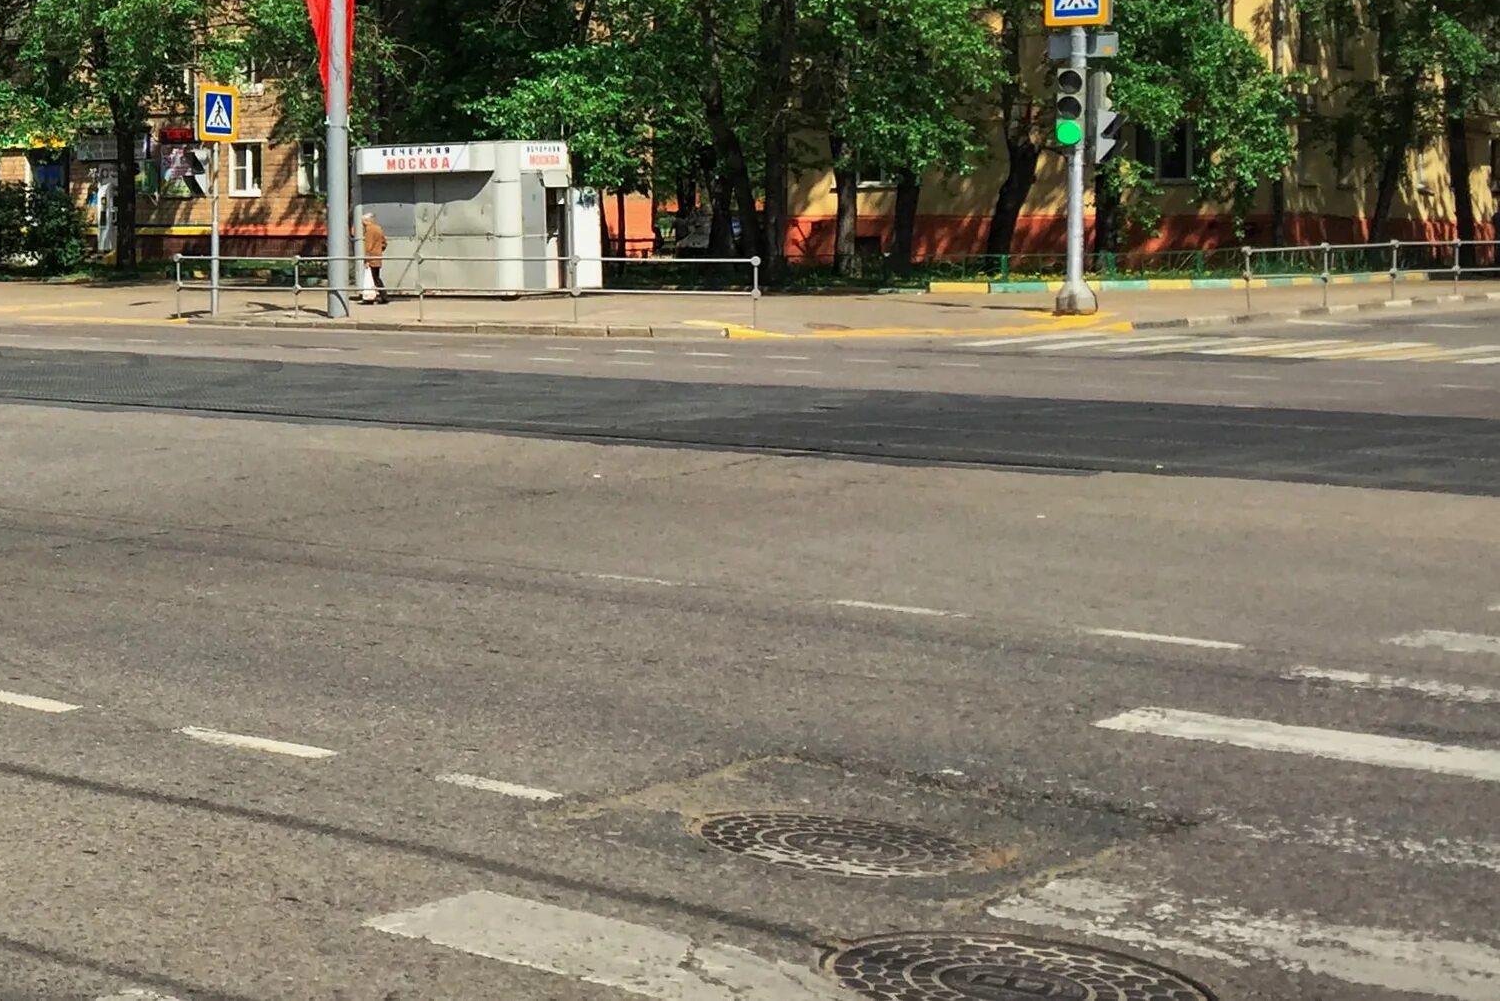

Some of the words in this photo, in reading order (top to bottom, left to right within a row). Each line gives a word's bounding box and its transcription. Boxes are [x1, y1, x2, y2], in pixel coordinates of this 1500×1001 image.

[382, 146, 450, 156] ВЕЧЕРНЯЯ
[387, 157, 450, 170] МОСКВА
[529, 154, 560, 165] МОСКВА
